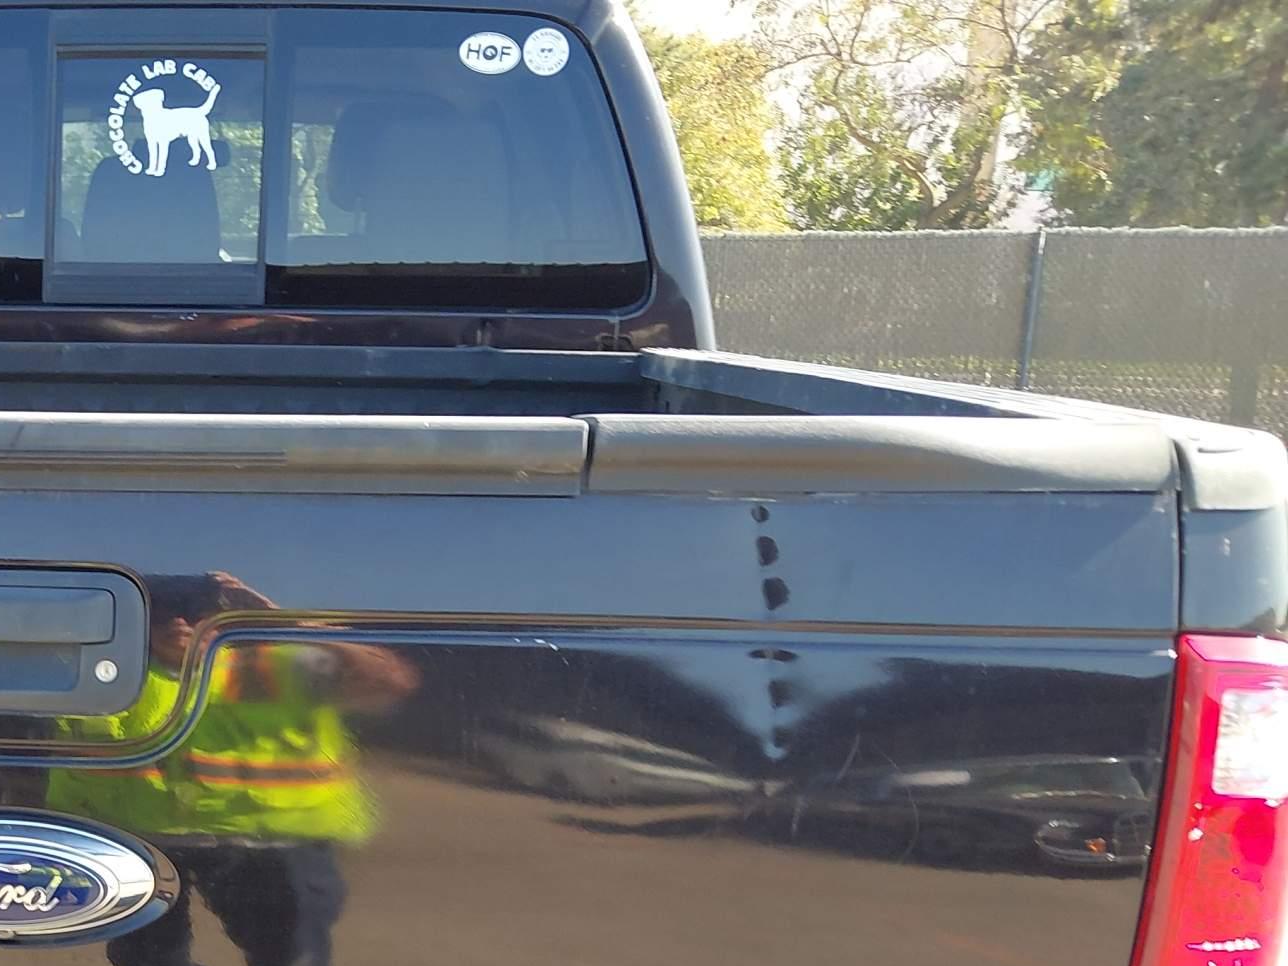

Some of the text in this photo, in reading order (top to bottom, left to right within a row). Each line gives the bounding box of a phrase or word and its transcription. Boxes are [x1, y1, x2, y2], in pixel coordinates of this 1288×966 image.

[466, 42, 512, 62] HOF
[108, 59, 216, 174] CHOCOLATE LAB CAB
